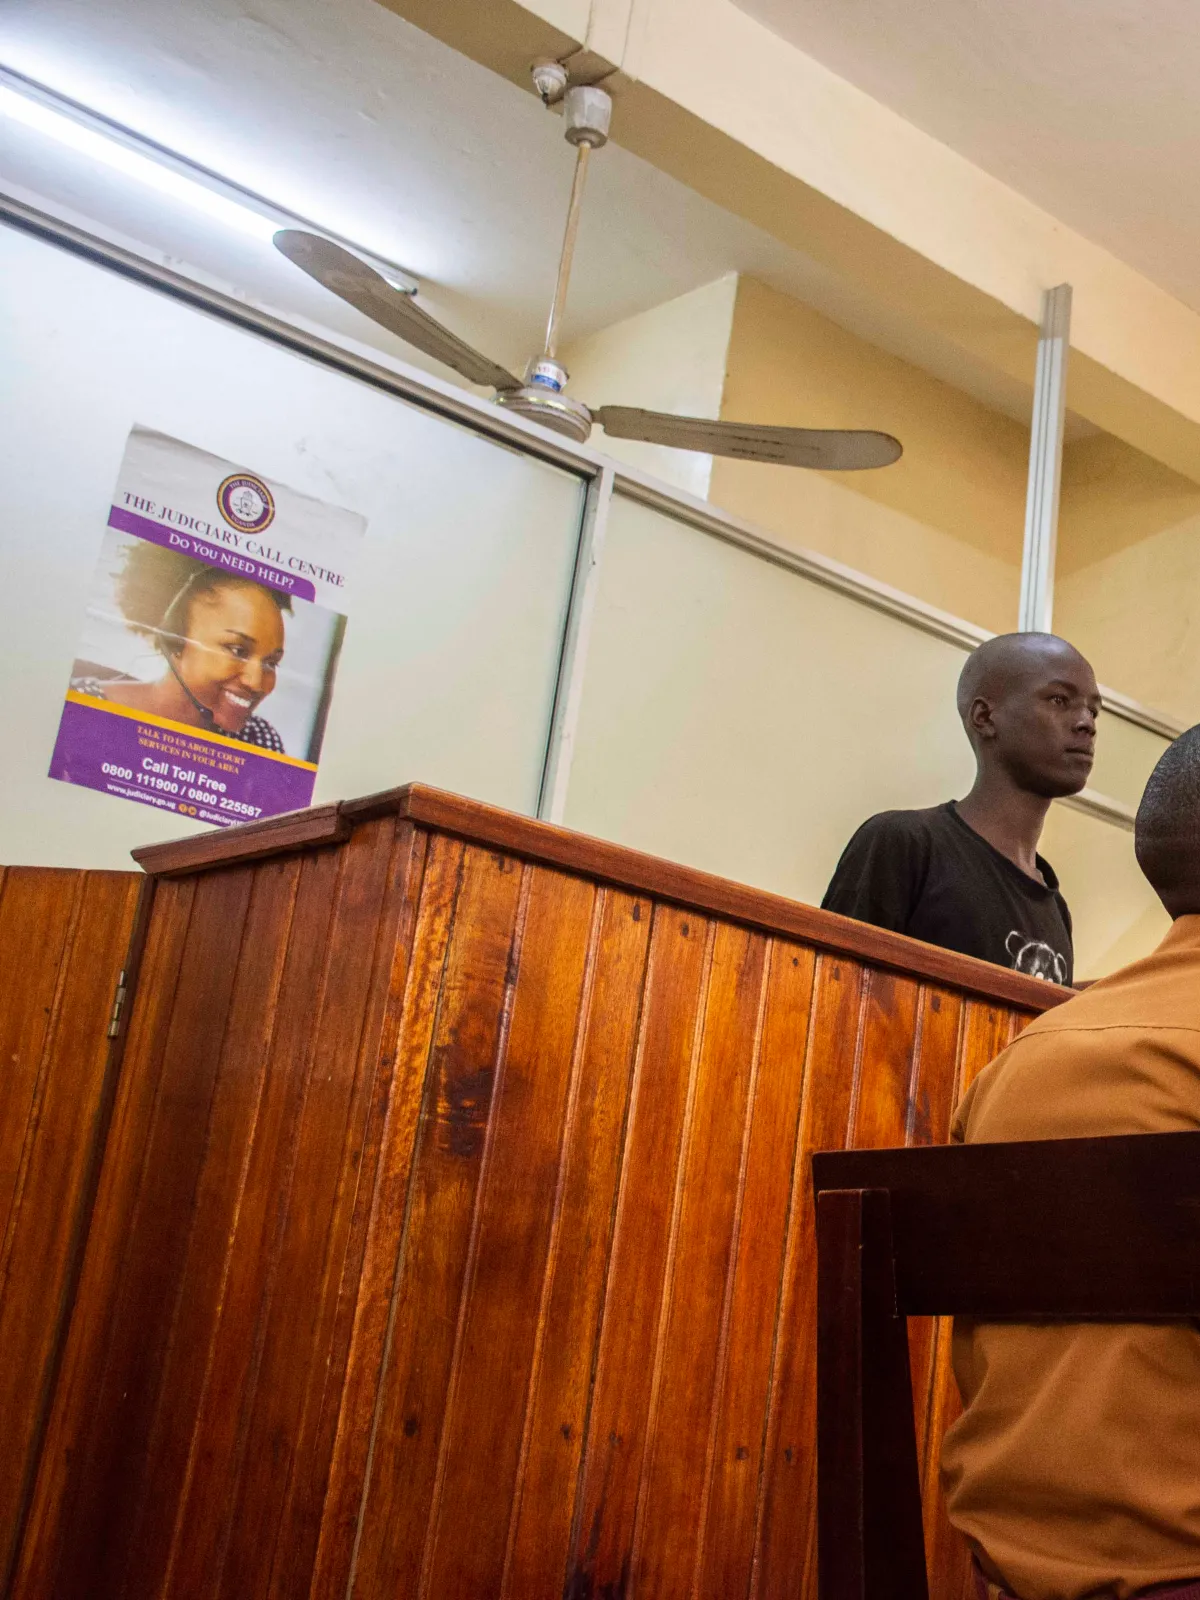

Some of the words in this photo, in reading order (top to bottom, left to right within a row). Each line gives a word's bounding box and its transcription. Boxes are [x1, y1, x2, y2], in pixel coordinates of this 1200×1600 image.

[123, 491, 157, 515] THE
[157, 506, 243, 547] JUDICIARY
[246, 540, 284, 565] CALL
[288, 556, 346, 587] CENTRE
[193, 541, 218, 561] YOU
[220, 552, 255, 575] NEED
[258, 565, 295, 589] HELP?
[137, 725, 160, 740] TALK
[163, 731, 175, 744] TO
[175, 735, 188, 748] US
[188, 741, 217, 758] ABOUT
[216, 748, 246, 766] COURT
[138, 737, 181, 757] SERVICES
[181, 749, 191, 760] IN
[191, 752, 216, 769] YOUR
[216, 759, 240, 775] AREA
[101, 762, 133, 781] 0800
[136, 771, 178, 795] 111900
[188, 789, 217, 806] 0800
[220, 797, 262, 819] 225587
[142, 757, 168, 776] Call
[171, 765, 197, 784] Toll
[198, 772, 227, 793] Free
[106, 782, 176, 810] www.judiciary.go.ug
